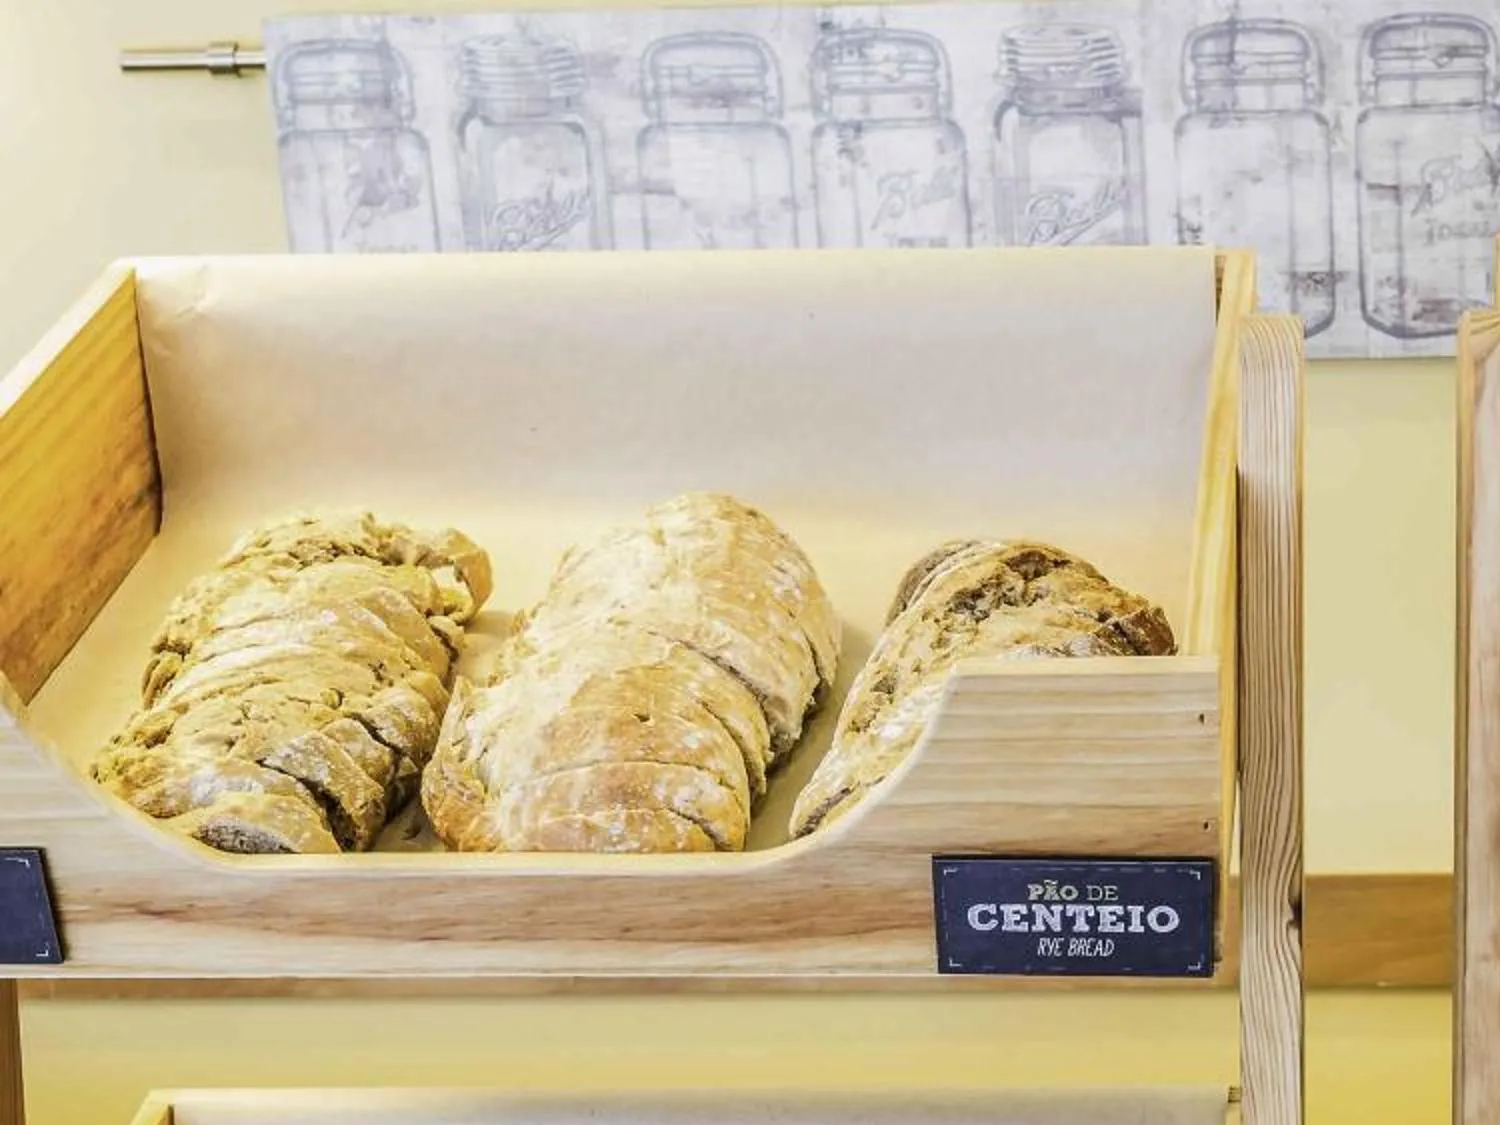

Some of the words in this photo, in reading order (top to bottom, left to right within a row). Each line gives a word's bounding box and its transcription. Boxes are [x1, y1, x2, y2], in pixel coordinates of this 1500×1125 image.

[1027, 880, 1079, 901] PÃO
[1086, 885, 1118, 901] DE
[967, 904, 1180, 934] CENTEIO
[1038, 938, 1064, 956] RYE
[1068, 938, 1115, 957] BREAD
